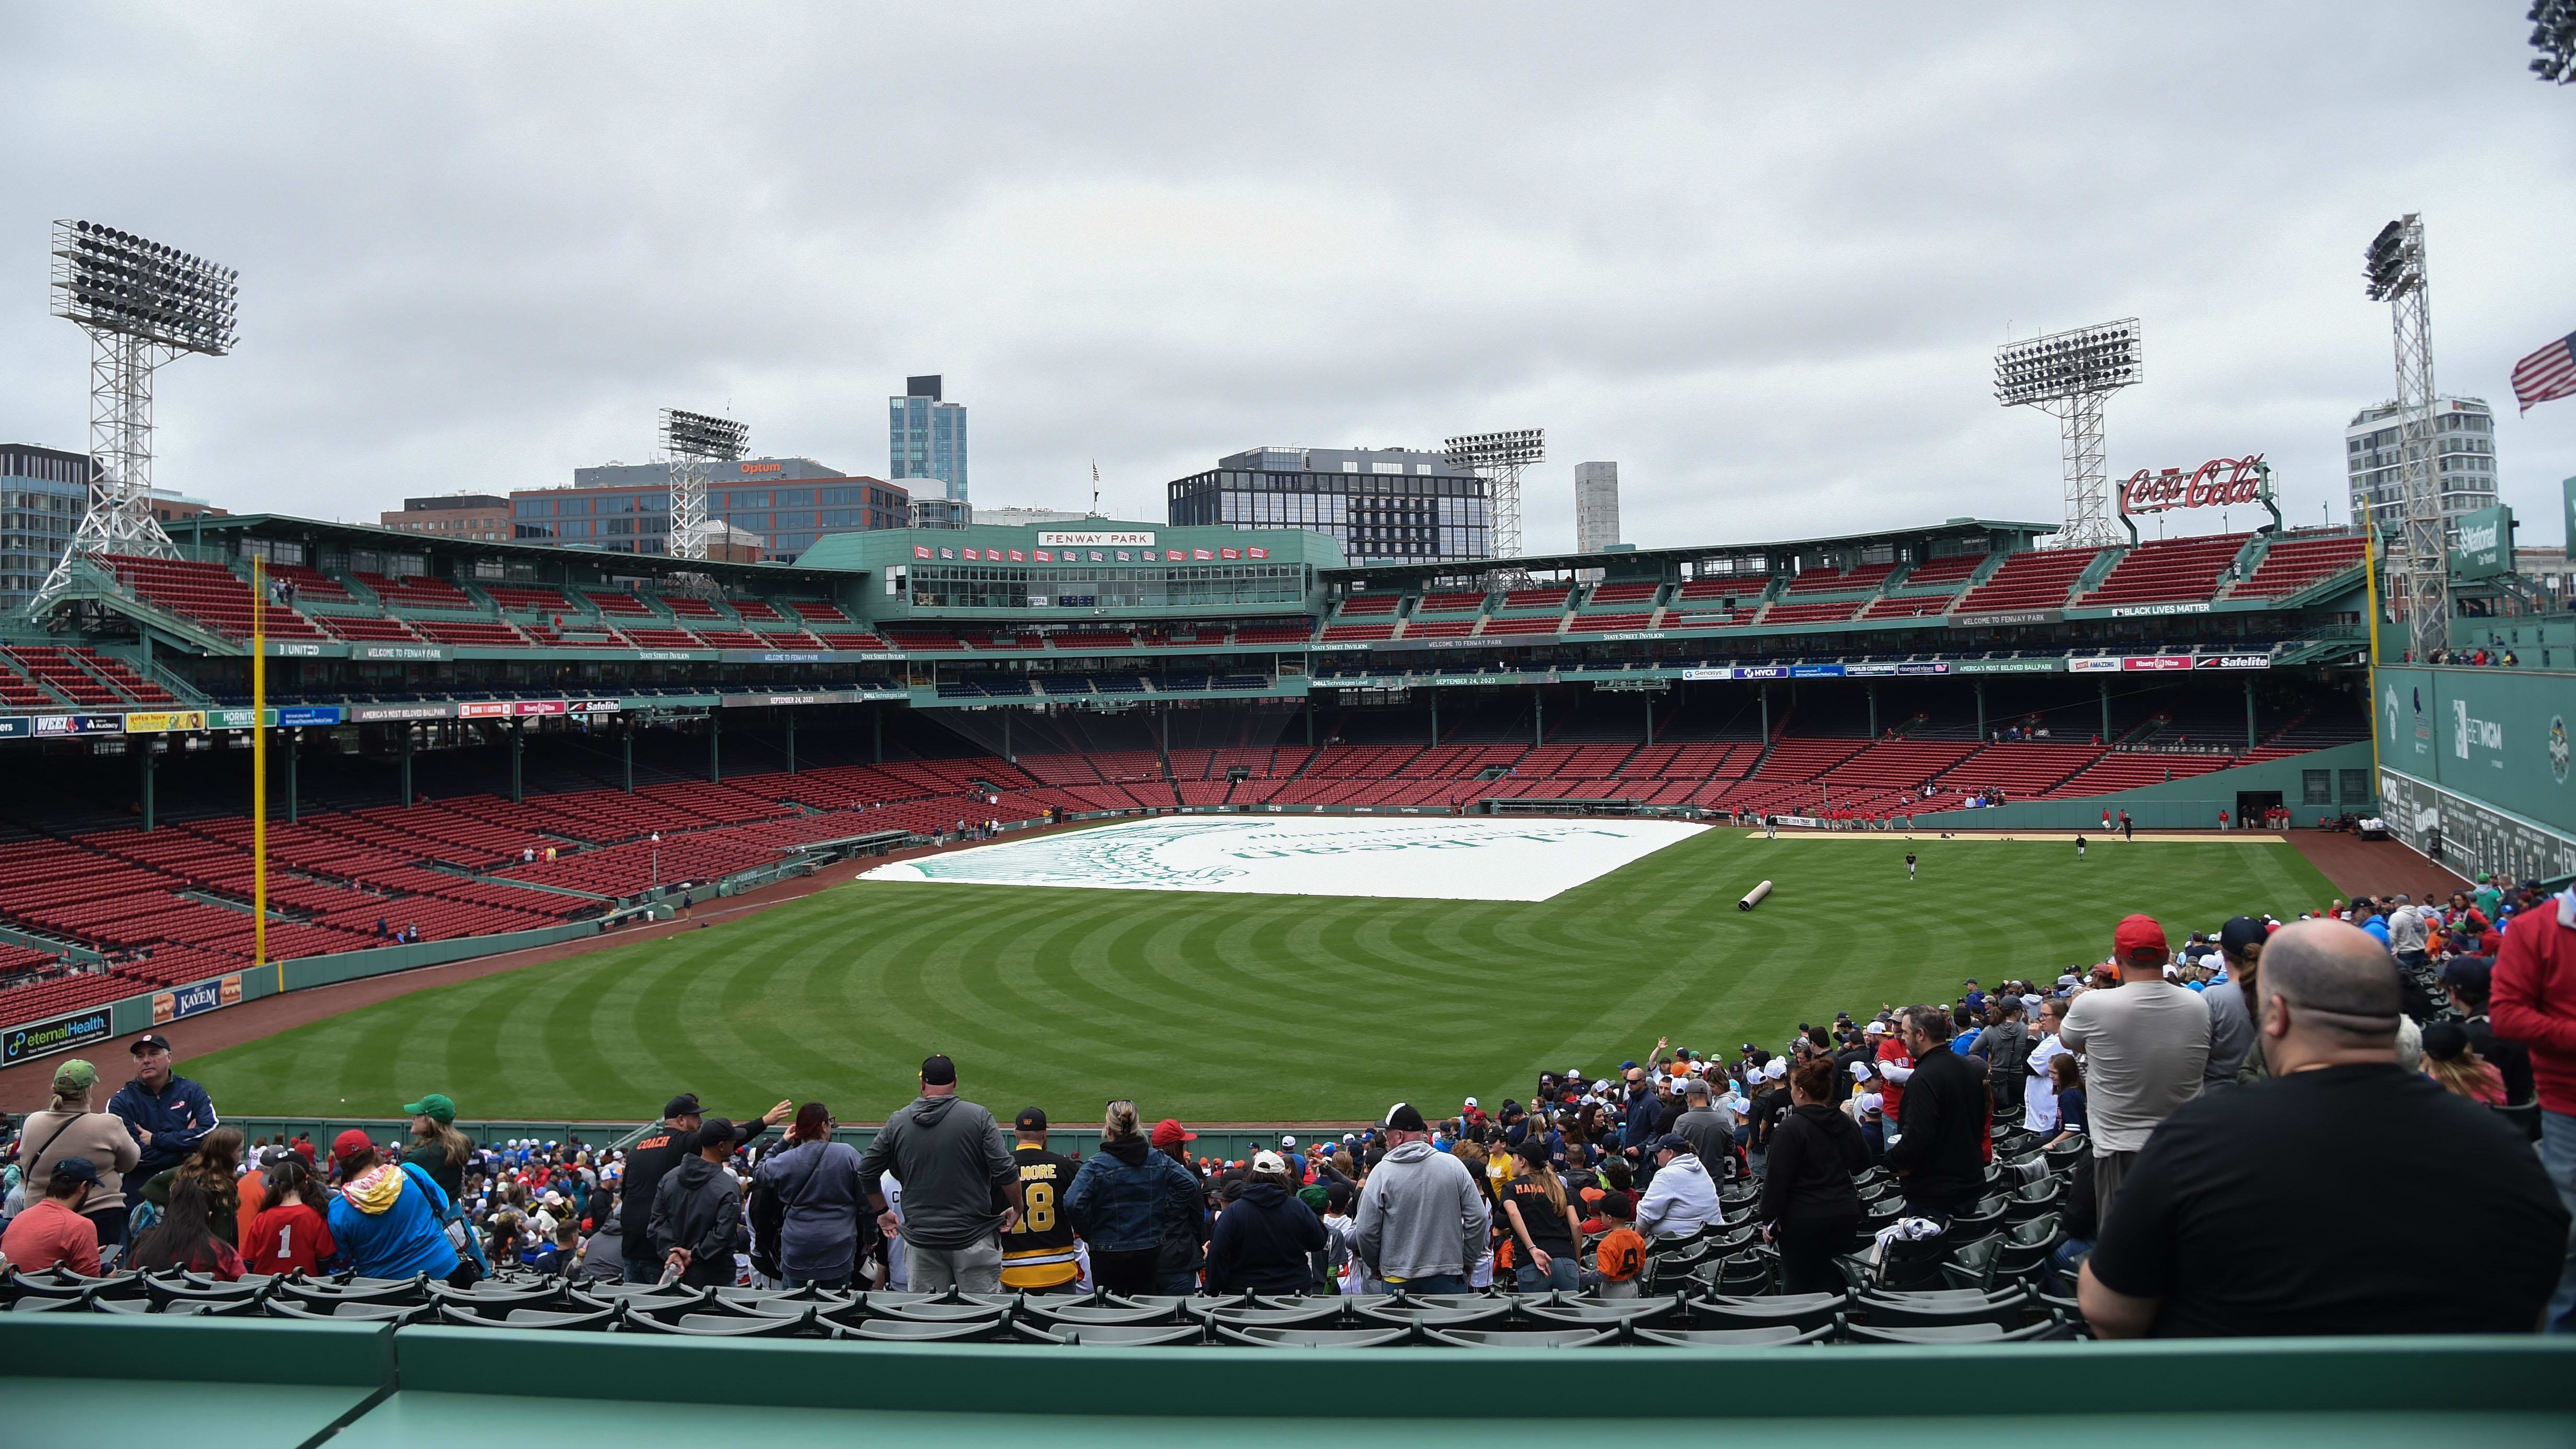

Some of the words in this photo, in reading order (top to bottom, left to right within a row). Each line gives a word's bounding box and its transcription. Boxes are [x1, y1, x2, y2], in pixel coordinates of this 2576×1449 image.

[741, 463, 780, 475] Optum
[2121, 453, 2264, 515] Coca-Cola
[1046, 535, 1102, 543] FENWAY
[1111, 535, 1147, 543] PARK
[2467, 521, 2497, 554] National
[2124, 607, 2150, 616] BLACK
[2152, 606, 2175, 615] LIVES
[2176, 604, 2210, 613] MATTER
[289, 645, 319, 655] UNITED
[368, 648, 394, 657] WELCOME
[404, 649, 426, 658] FENWAY
[427, 650, 441, 658] PARK
[2221, 657, 2267, 666] Safelite
[586, 701, 618, 710] Safelite
[224, 711, 255, 721] HORNIT
[362, 710, 387, 719] AMERICA'S
[388, 710, 401, 718] MOST
[402, 709, 422, 718] BELOVED
[423, 708, 446, 717] BALLPARK
[38, 717, 68, 730] WEEI
[2467, 718, 2502, 750] BETMGM
[180, 988, 216, 1015] KAYEM
[27, 1015, 105, 1046] eternalHealth
[76, 1033, 96, 1041] Advantage
[636, 1136, 671, 1150] COACH
[1019, 1164, 1056, 1181] MORE
[278, 1224, 291, 1258] 1
